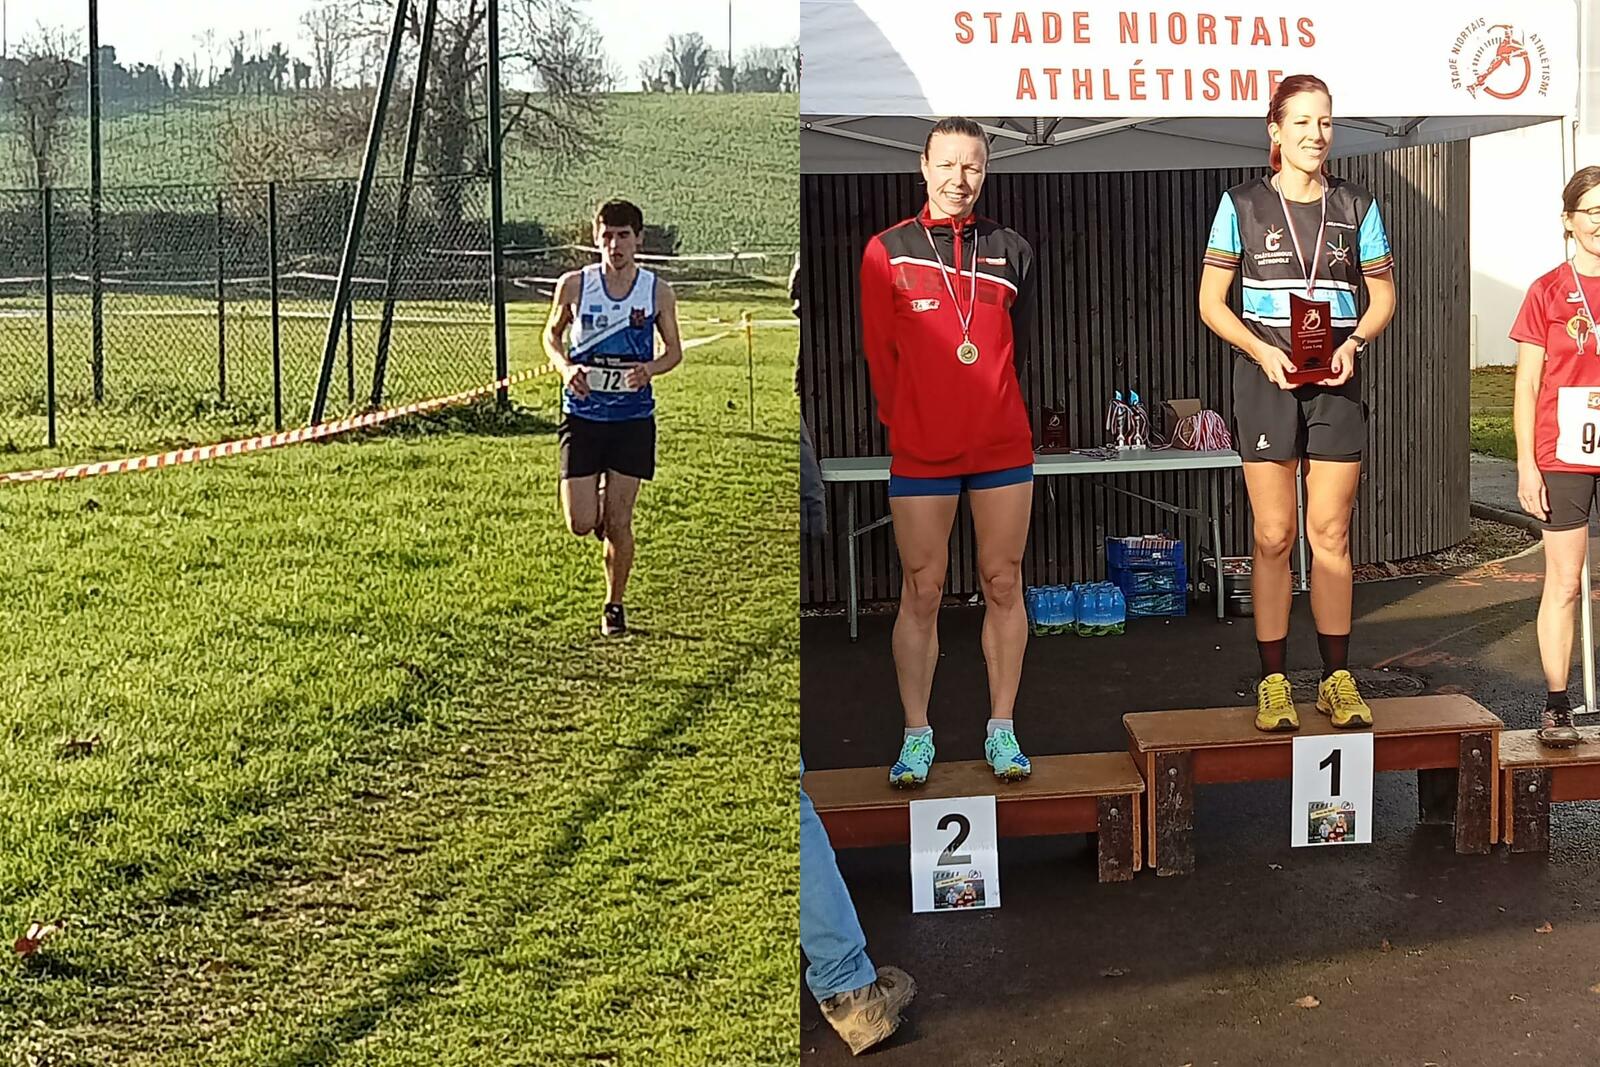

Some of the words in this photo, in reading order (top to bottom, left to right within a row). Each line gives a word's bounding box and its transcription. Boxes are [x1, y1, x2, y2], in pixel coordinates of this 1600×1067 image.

[954, 11, 1091, 44] STADE
[1119, 11, 1316, 48] NIORTAIS
[1451, 17, 1486, 55] NIORTAIS
[1448, 58, 1462, 90] STADE
[602, 370, 621, 390] 72
[1582, 422, 1600, 454] 9
[1320, 749, 1341, 796] 1
[937, 814, 972, 866] 2
